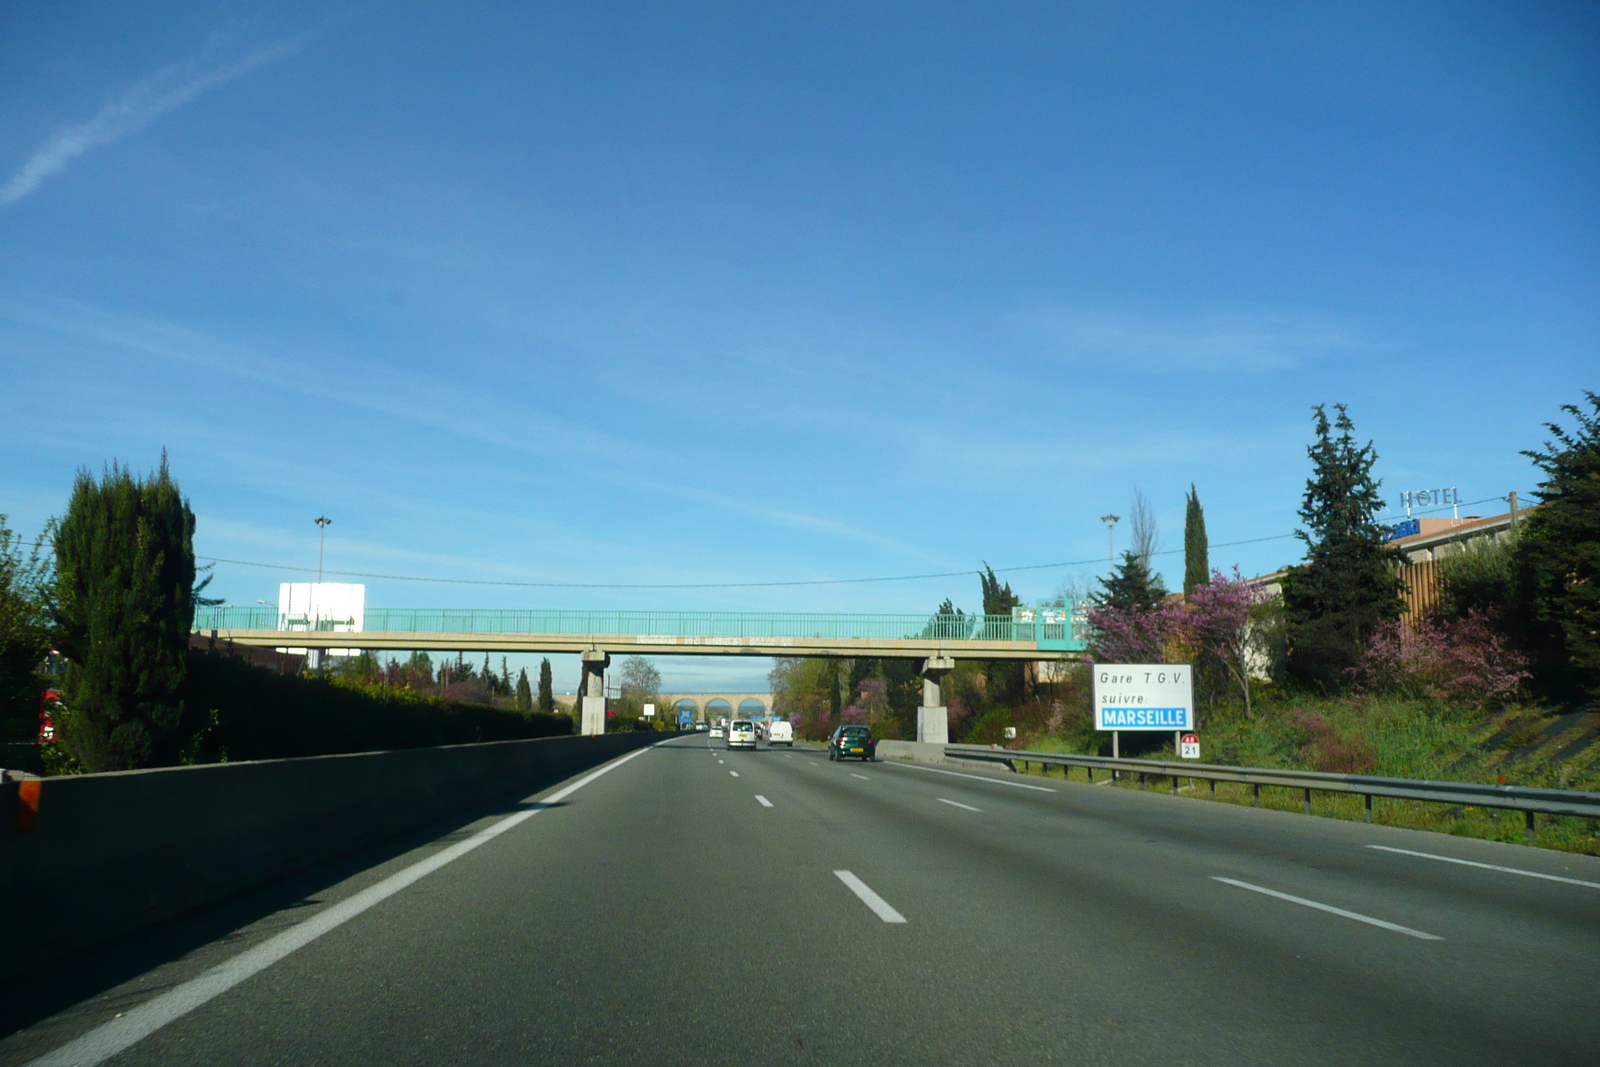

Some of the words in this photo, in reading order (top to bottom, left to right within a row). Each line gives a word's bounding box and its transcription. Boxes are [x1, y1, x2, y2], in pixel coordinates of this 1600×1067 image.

[1400, 487, 1462, 507] HOTEL
[1100, 672, 1133, 684] Gare
[1104, 709, 1184, 725] MARSEILLE
[1185, 746, 1196, 755] 21
